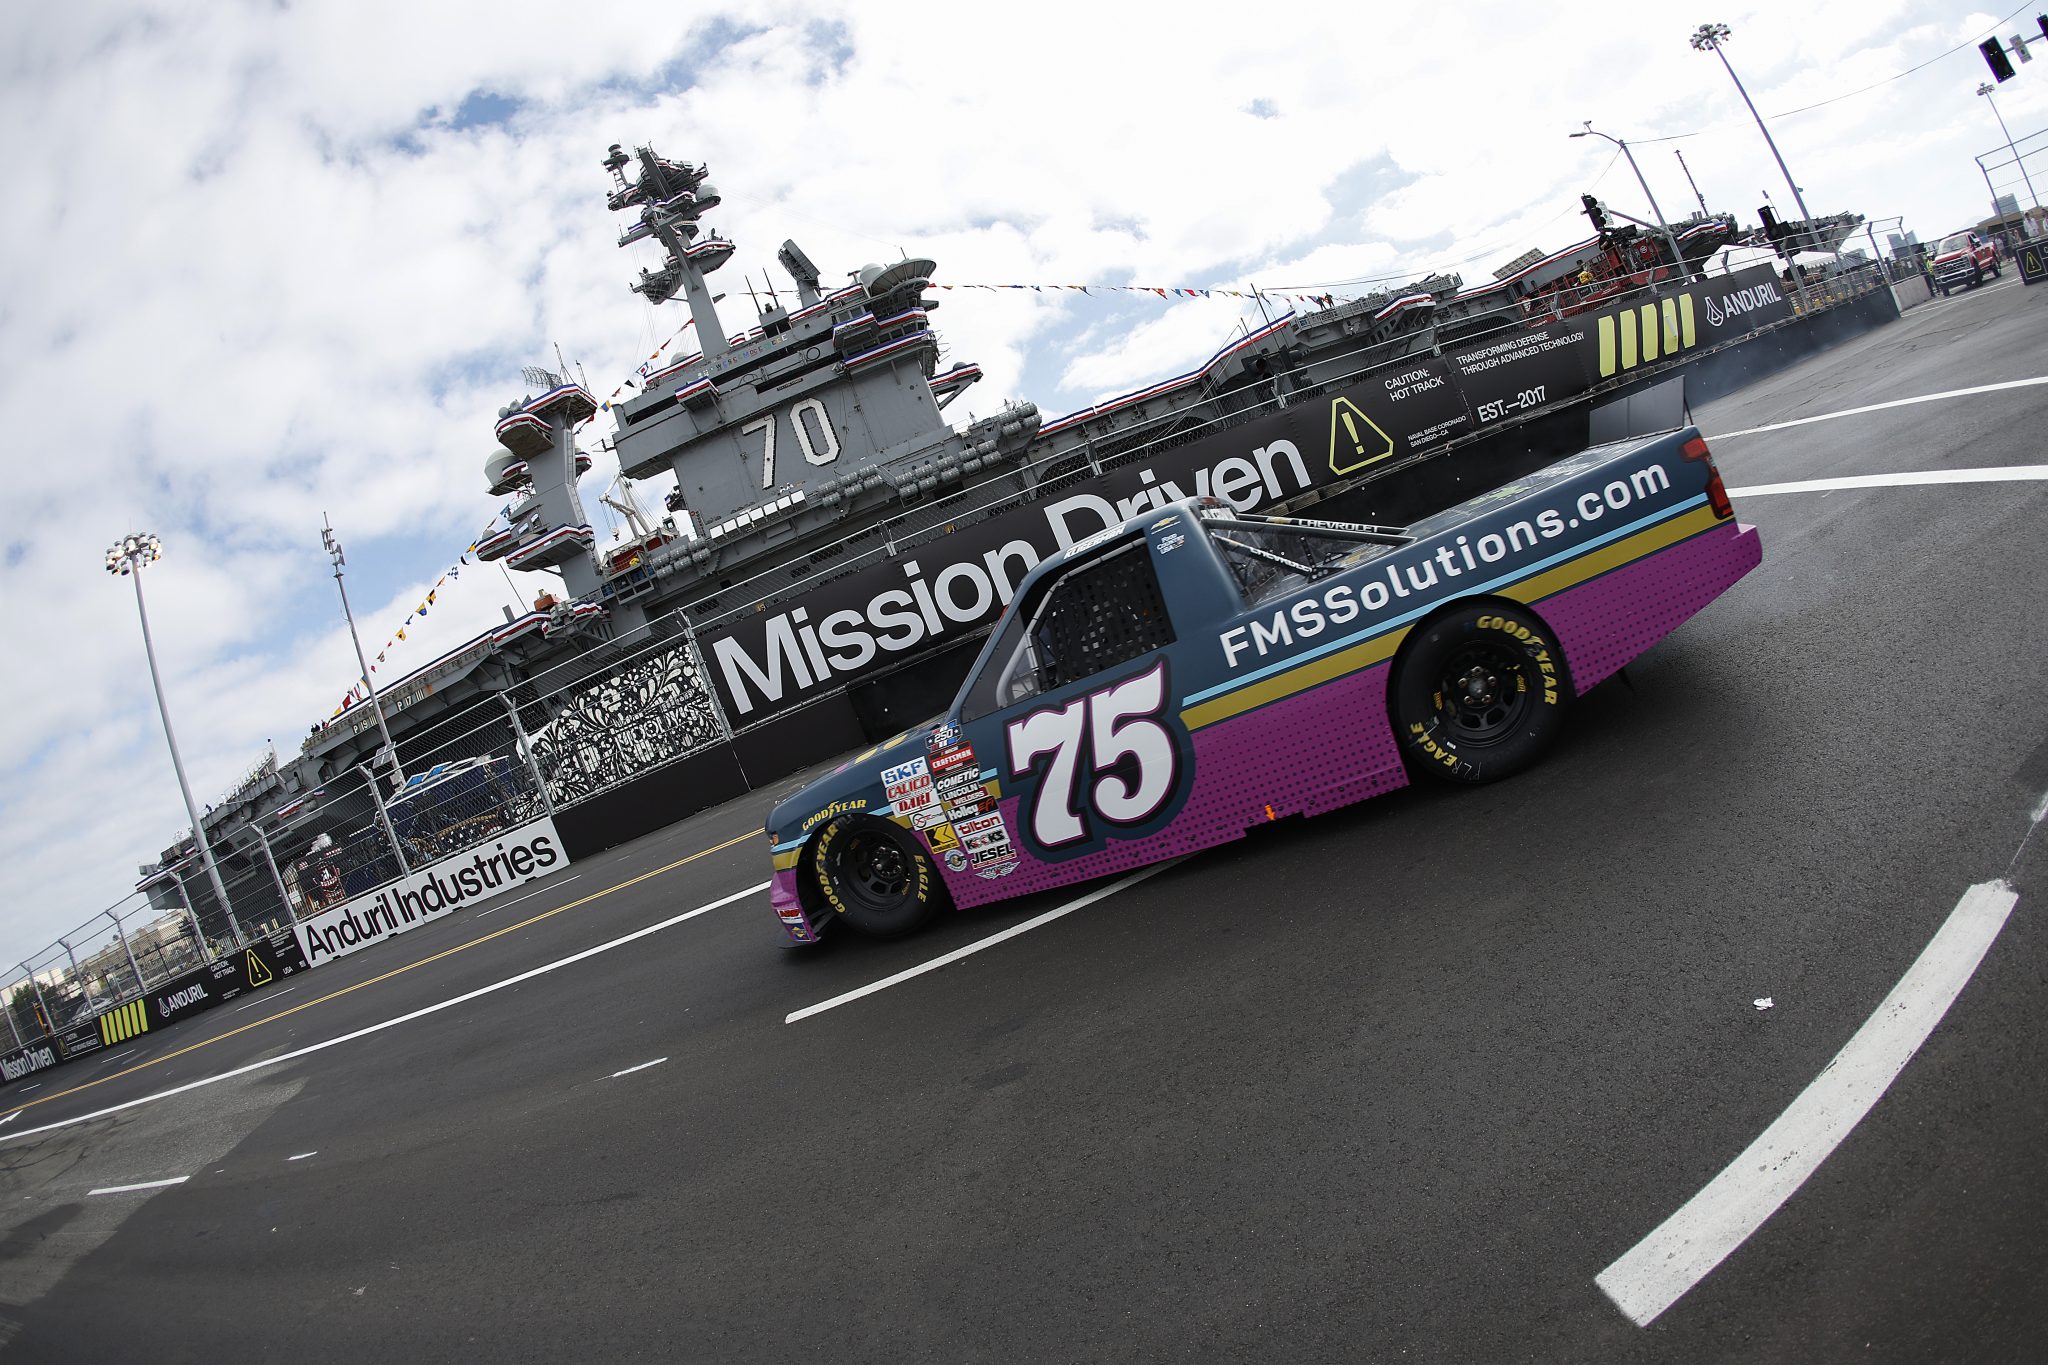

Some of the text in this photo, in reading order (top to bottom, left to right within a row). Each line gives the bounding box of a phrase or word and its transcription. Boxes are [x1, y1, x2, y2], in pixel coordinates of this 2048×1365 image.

[1723, 282, 1782, 318] ANDURIL
[1456, 331, 1550, 365] TRANSFORMING DEFENSE
[1460, 331, 1585, 376] THROUGH ADVANCED TECHNOLOGY
[1384, 368, 1431, 390] CAUTION:
[1389, 375, 1445, 402] HOT TRACK
[1407, 415, 1467, 442] NAVAL BASE CORONADO
[741, 397, 842, 490] 70
[1410, 438, 1422, 448] SAN
[1298, 519, 1380, 533] CHEVROLET
[1219, 464, 1671, 668] FMSSolutions.com
[712, 540, 1040, 715] Mission
[1476, 615, 1558, 705] GOODYEAR
[934, 728, 953, 743] 250
[1410, 721, 1458, 767] EAGLE
[932, 749, 972, 769] CRAFTSMAN
[1008, 661, 1175, 846] 75
[884, 760, 924, 785] SKF
[888, 776, 931, 799] CALICO
[943, 782, 979, 801] LINCOLN
[953, 791, 985, 806] WELDERS
[802, 799, 867, 831] GOODYEAR
[948, 804, 979, 822] Holley
[958, 815, 1001, 835] tilton
[972, 843, 1014, 865] JESEL
[914, 855, 929, 903] EAGLE
[306, 835, 557, 961] Anduril Industries
[222, 965, 237, 976] TRACK
[168, 983, 209, 1012] ANDURIL
